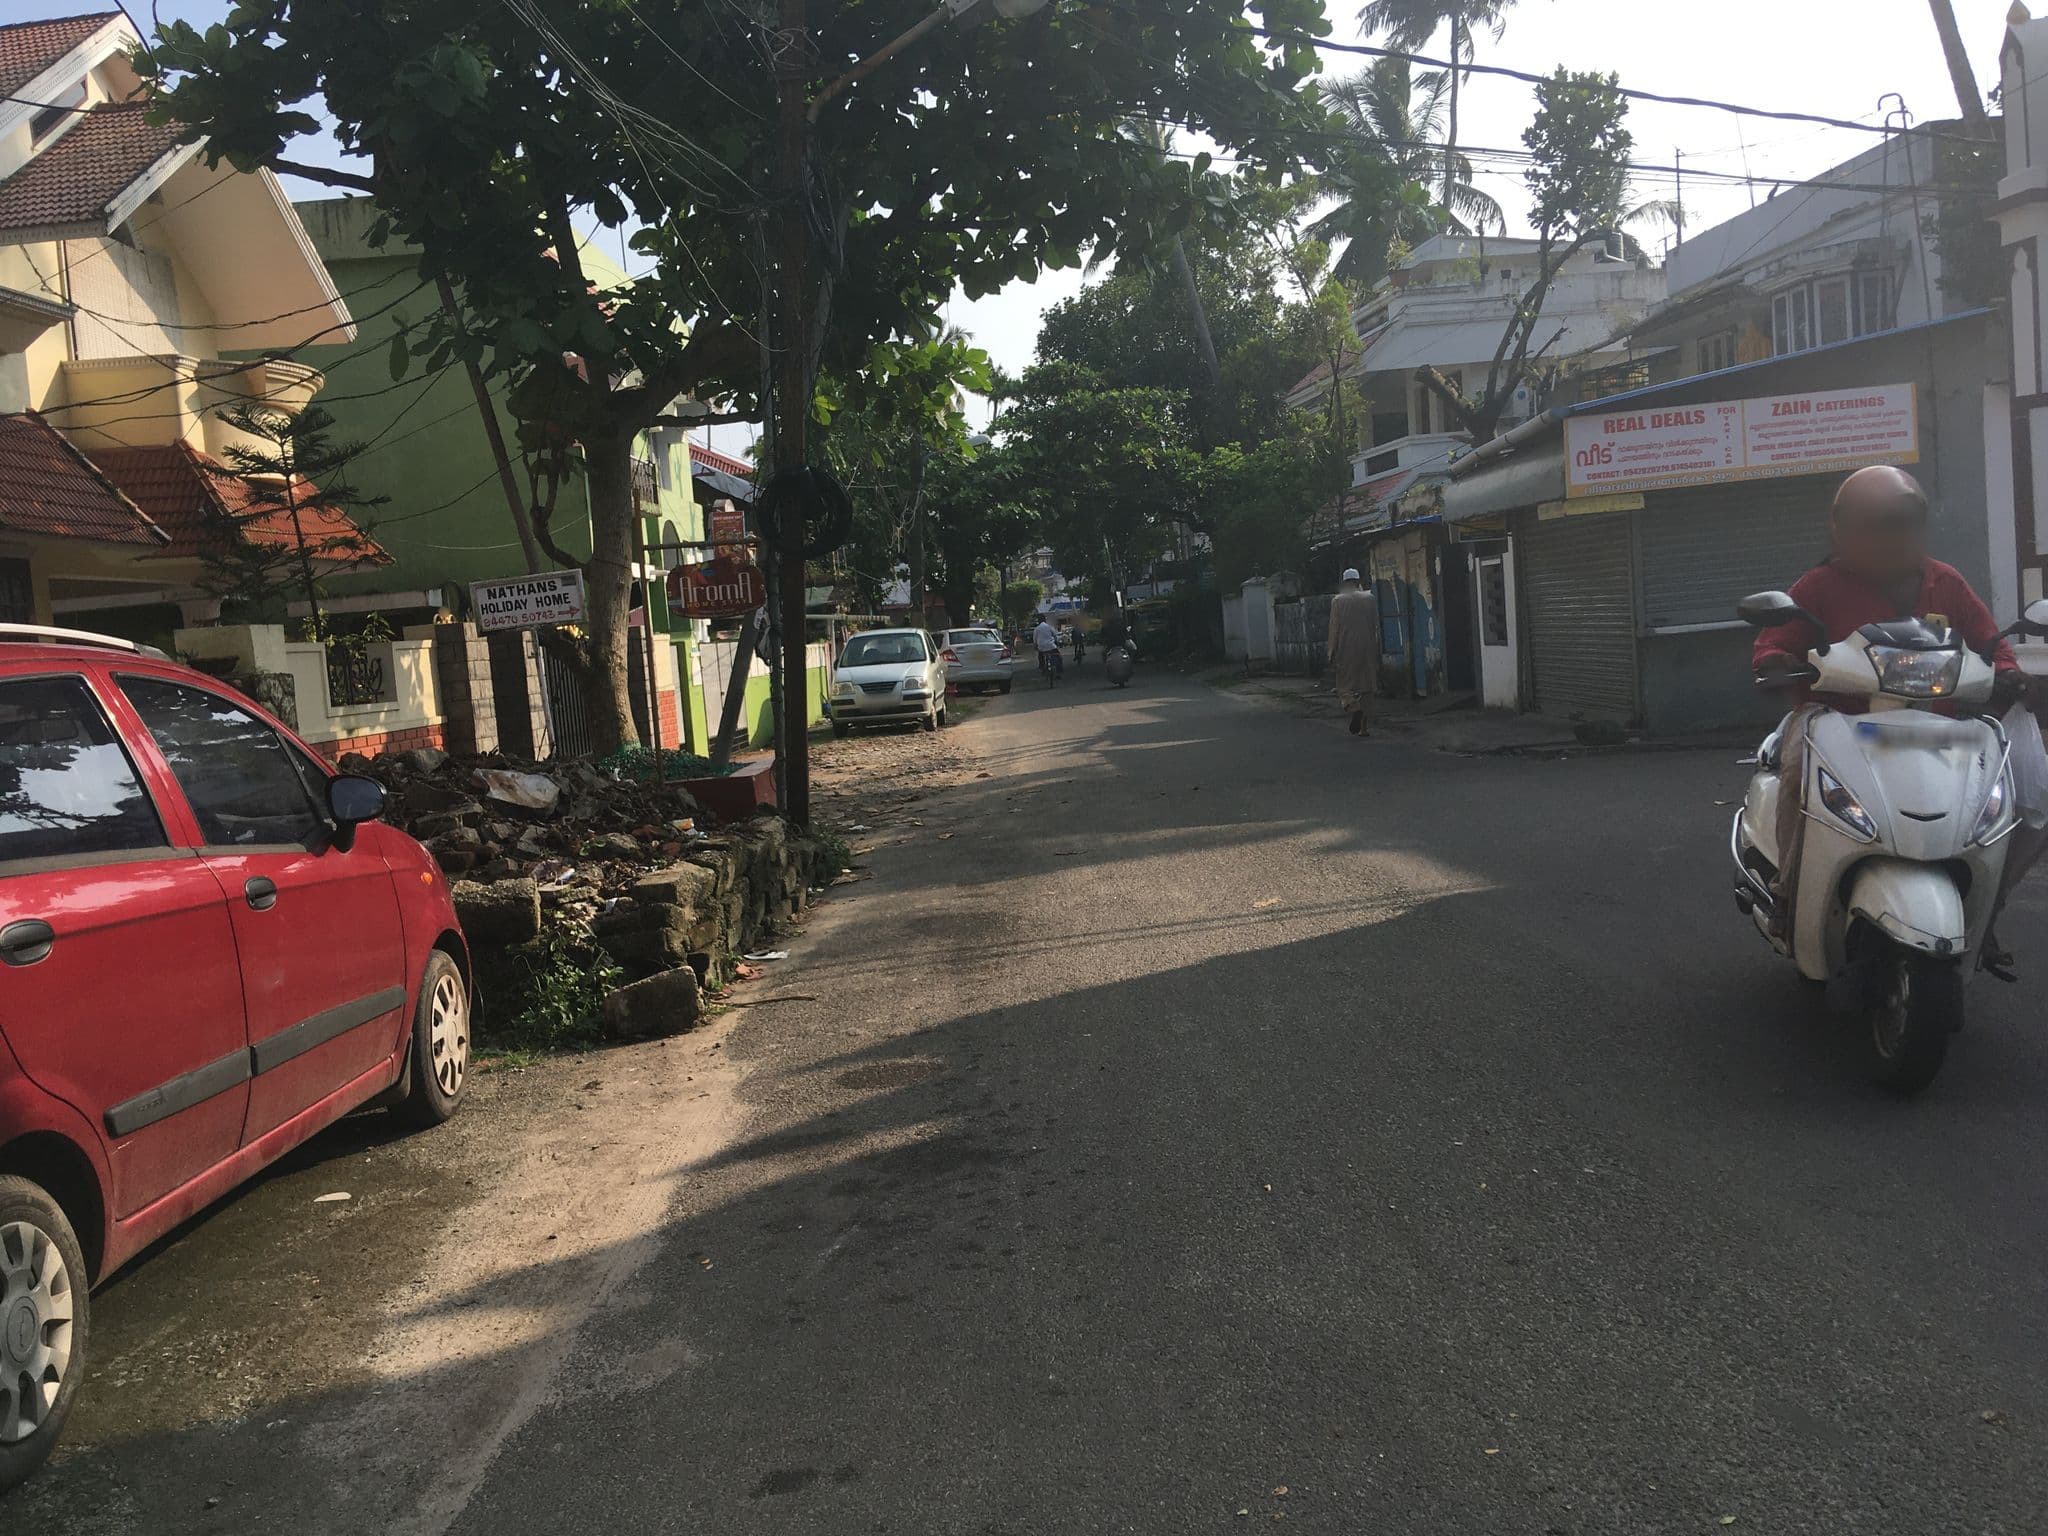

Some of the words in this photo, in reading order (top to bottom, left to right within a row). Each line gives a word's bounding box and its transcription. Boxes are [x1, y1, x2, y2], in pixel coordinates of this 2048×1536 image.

[1717, 406, 1736, 415] FOR
[1771, 400, 1811, 417] ZAIN
[1815, 396, 1886, 412] CATERINGS
[1603, 415, 1647, 434] REAL
[1651, 410, 1706, 429] DEALS
[1576, 441, 1616, 468] വീട്
[486, 580, 558, 600] NATHANS
[480, 599, 528, 615] HOLIDAY
[535, 592, 571, 608] HOME
